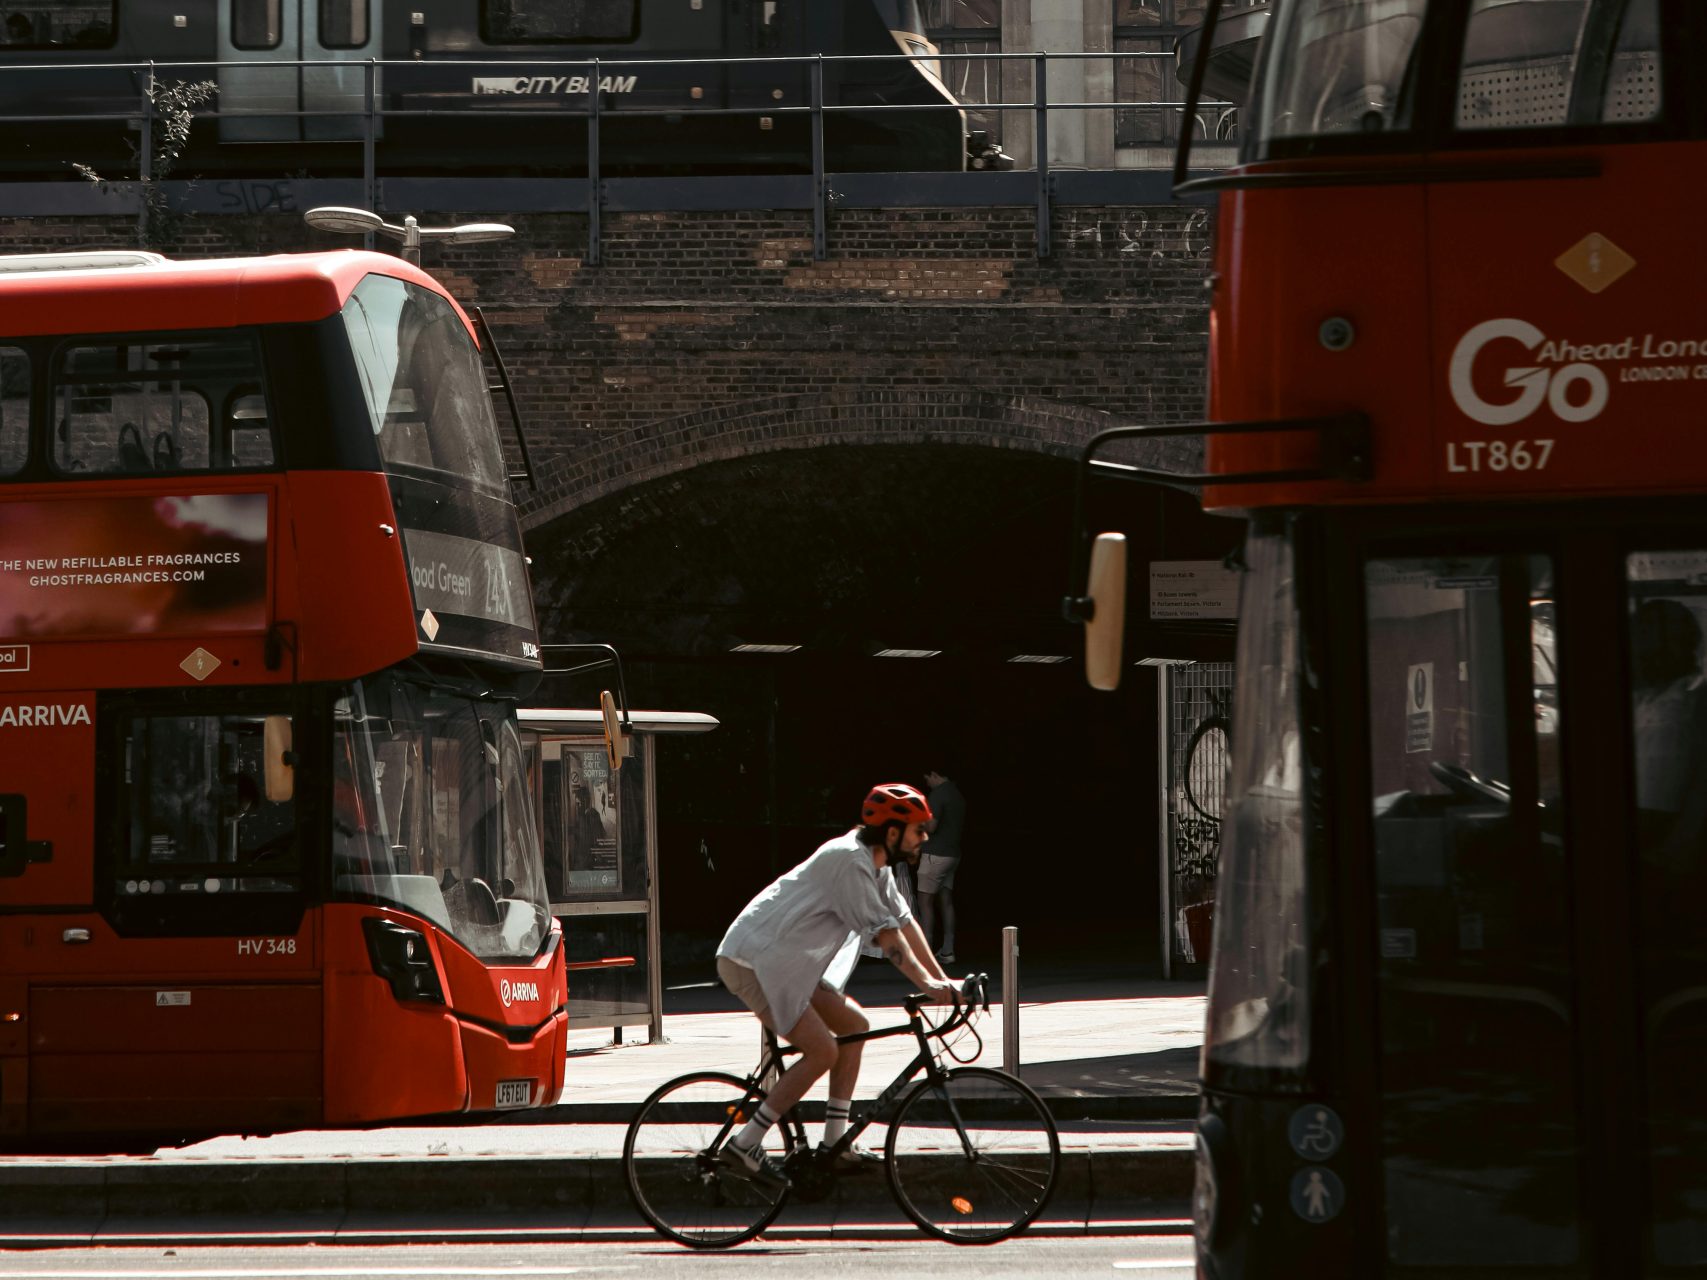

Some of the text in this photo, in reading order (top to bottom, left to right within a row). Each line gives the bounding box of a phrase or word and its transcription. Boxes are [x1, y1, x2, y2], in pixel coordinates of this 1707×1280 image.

[513, 76, 566, 94] CITY
[1449, 318, 1609, 426] Go
[1620, 366, 1688, 381] LONDON
[1447, 440, 1554, 473] LT867
[26, 559, 58, 570] NEW
[62, 556, 143, 568] REFILLABLE
[147, 552, 241, 566] FRAGRANCES
[29, 571, 205, 587] GHOSTFRAGRANCES.COM
[438, 562, 472, 596] Green
[0, 705, 91, 728] ARRIVA
[238, 939, 297, 955] HV 348
[511, 982, 540, 1001] ARRIVA
